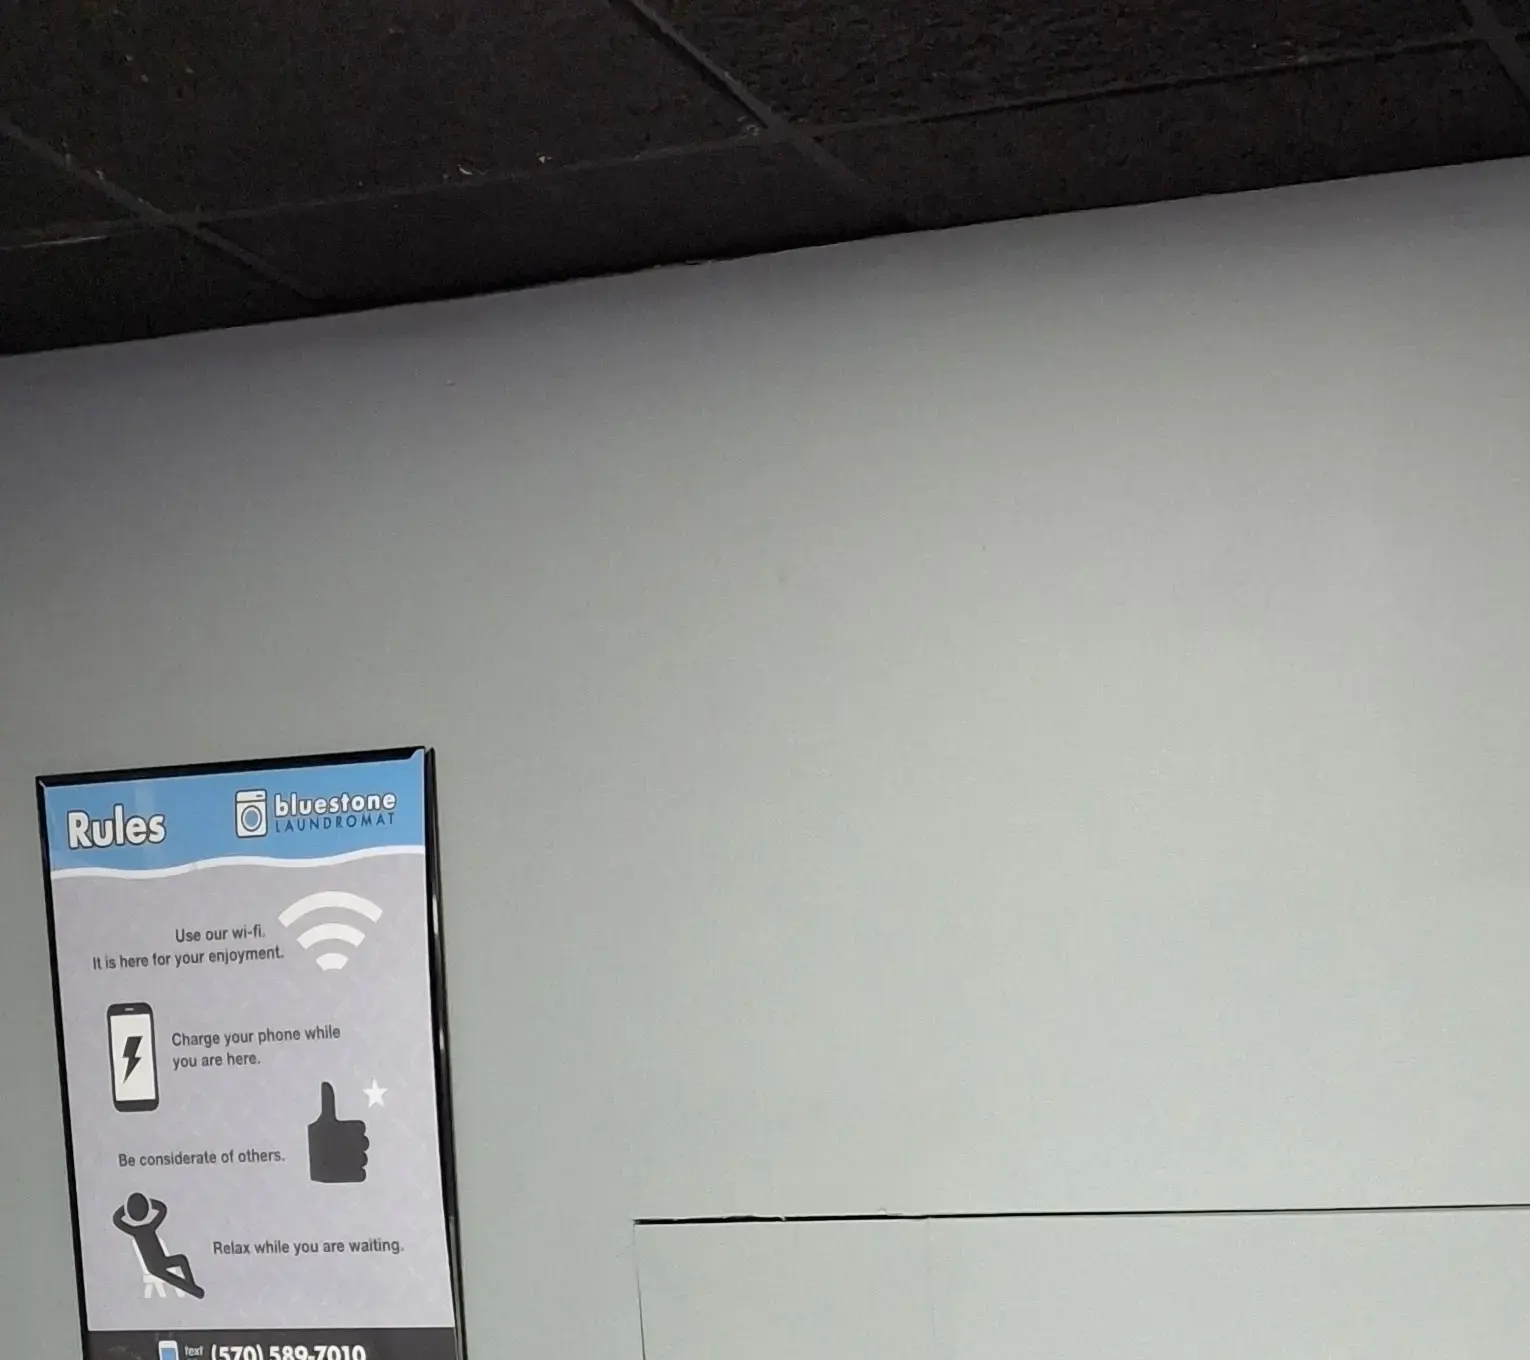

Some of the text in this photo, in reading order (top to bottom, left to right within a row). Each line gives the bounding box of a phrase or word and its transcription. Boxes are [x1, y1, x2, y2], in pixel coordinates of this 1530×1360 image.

[273, 790, 397, 818] bluestone
[67, 804, 167, 849] Rules
[274, 813, 396, 834] LAUNDROMAT
[175, 924, 266, 944] Use our wi-fi.
[92, 945, 285, 970] It is here for your enjoyment.
[171, 1025, 341, 1048] Charge your phone while
[173, 1051, 260, 1071] you are here.
[118, 1148, 286, 1167] Be considerate of others.
[213, 1238, 405, 1257] Relax while you are waiting.
[185, 1345, 204, 1357] text
